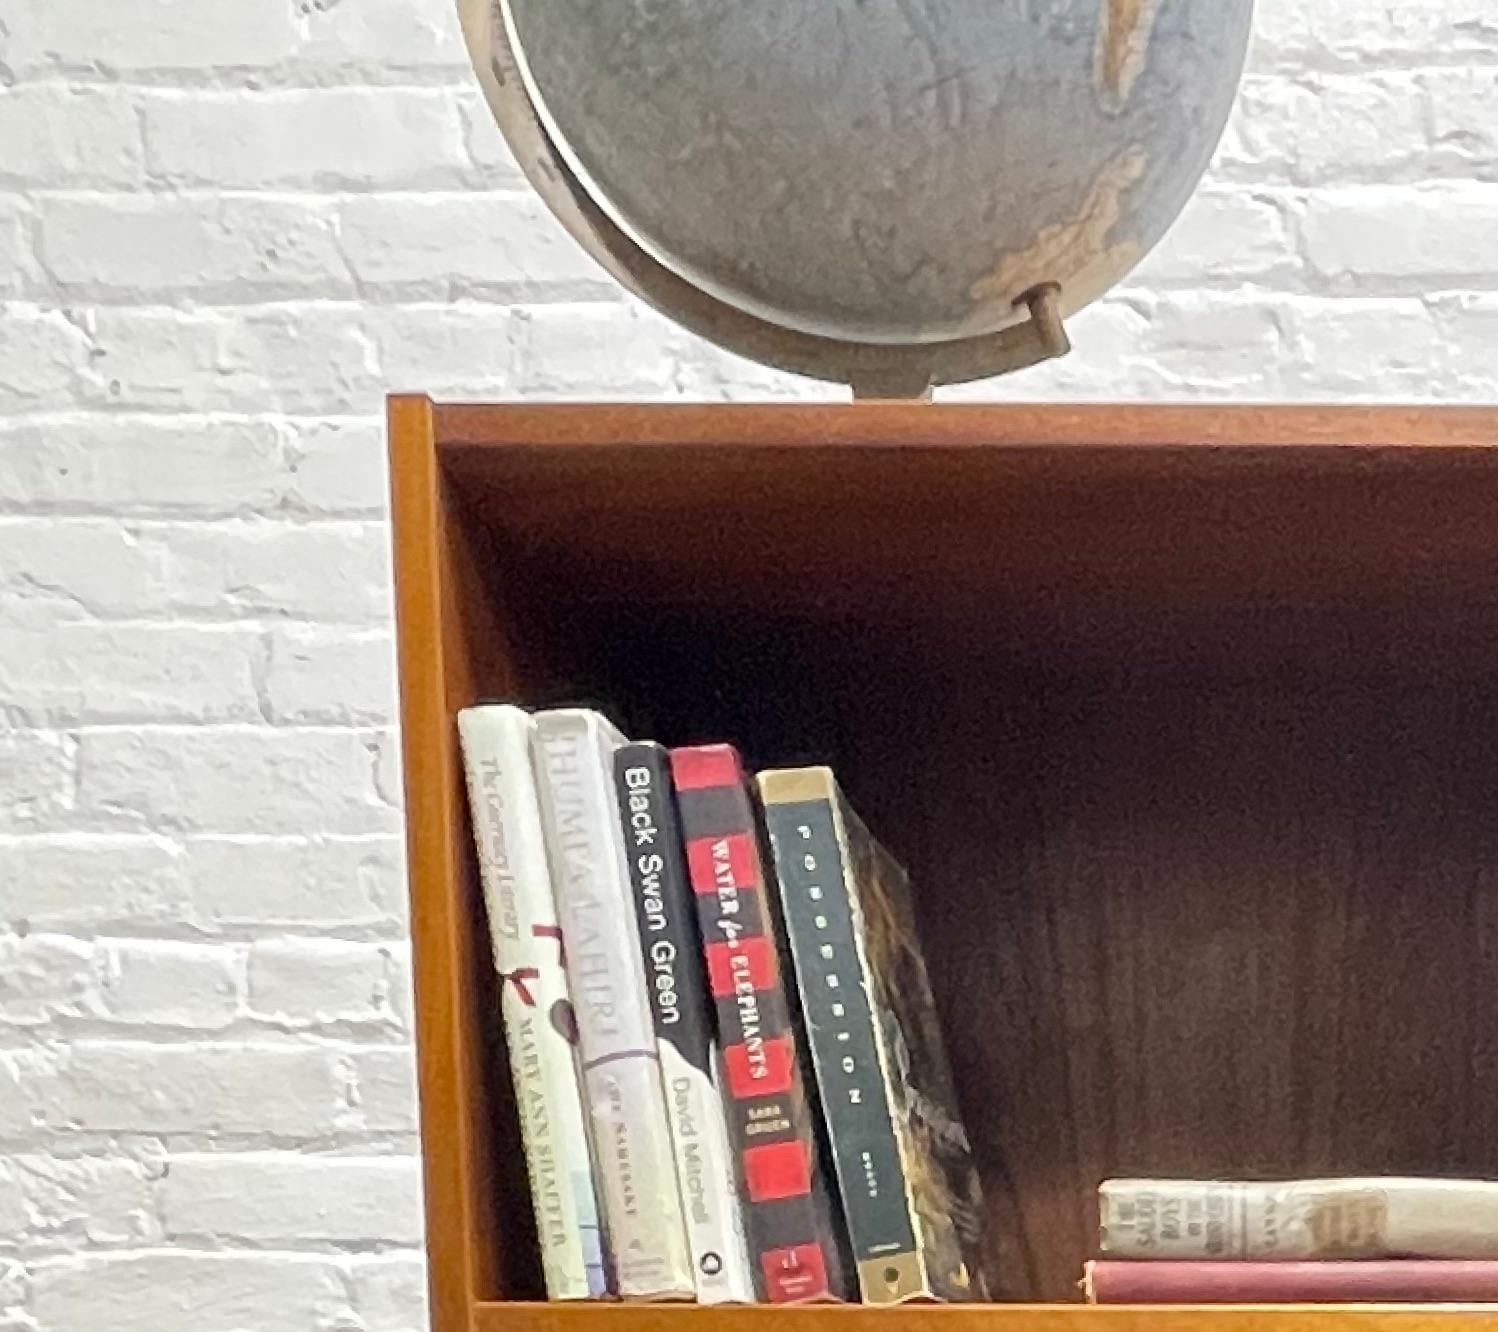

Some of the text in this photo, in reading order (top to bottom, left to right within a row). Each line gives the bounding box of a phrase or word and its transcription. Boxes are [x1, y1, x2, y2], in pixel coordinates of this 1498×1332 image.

[625, 767, 680, 1025] Black Swan Green
[711, 839, 740, 915] WATER
[717, 918, 744, 949] for
[730, 954, 769, 1080] ELEPHANTS
[672, 1076, 699, 1139] David
